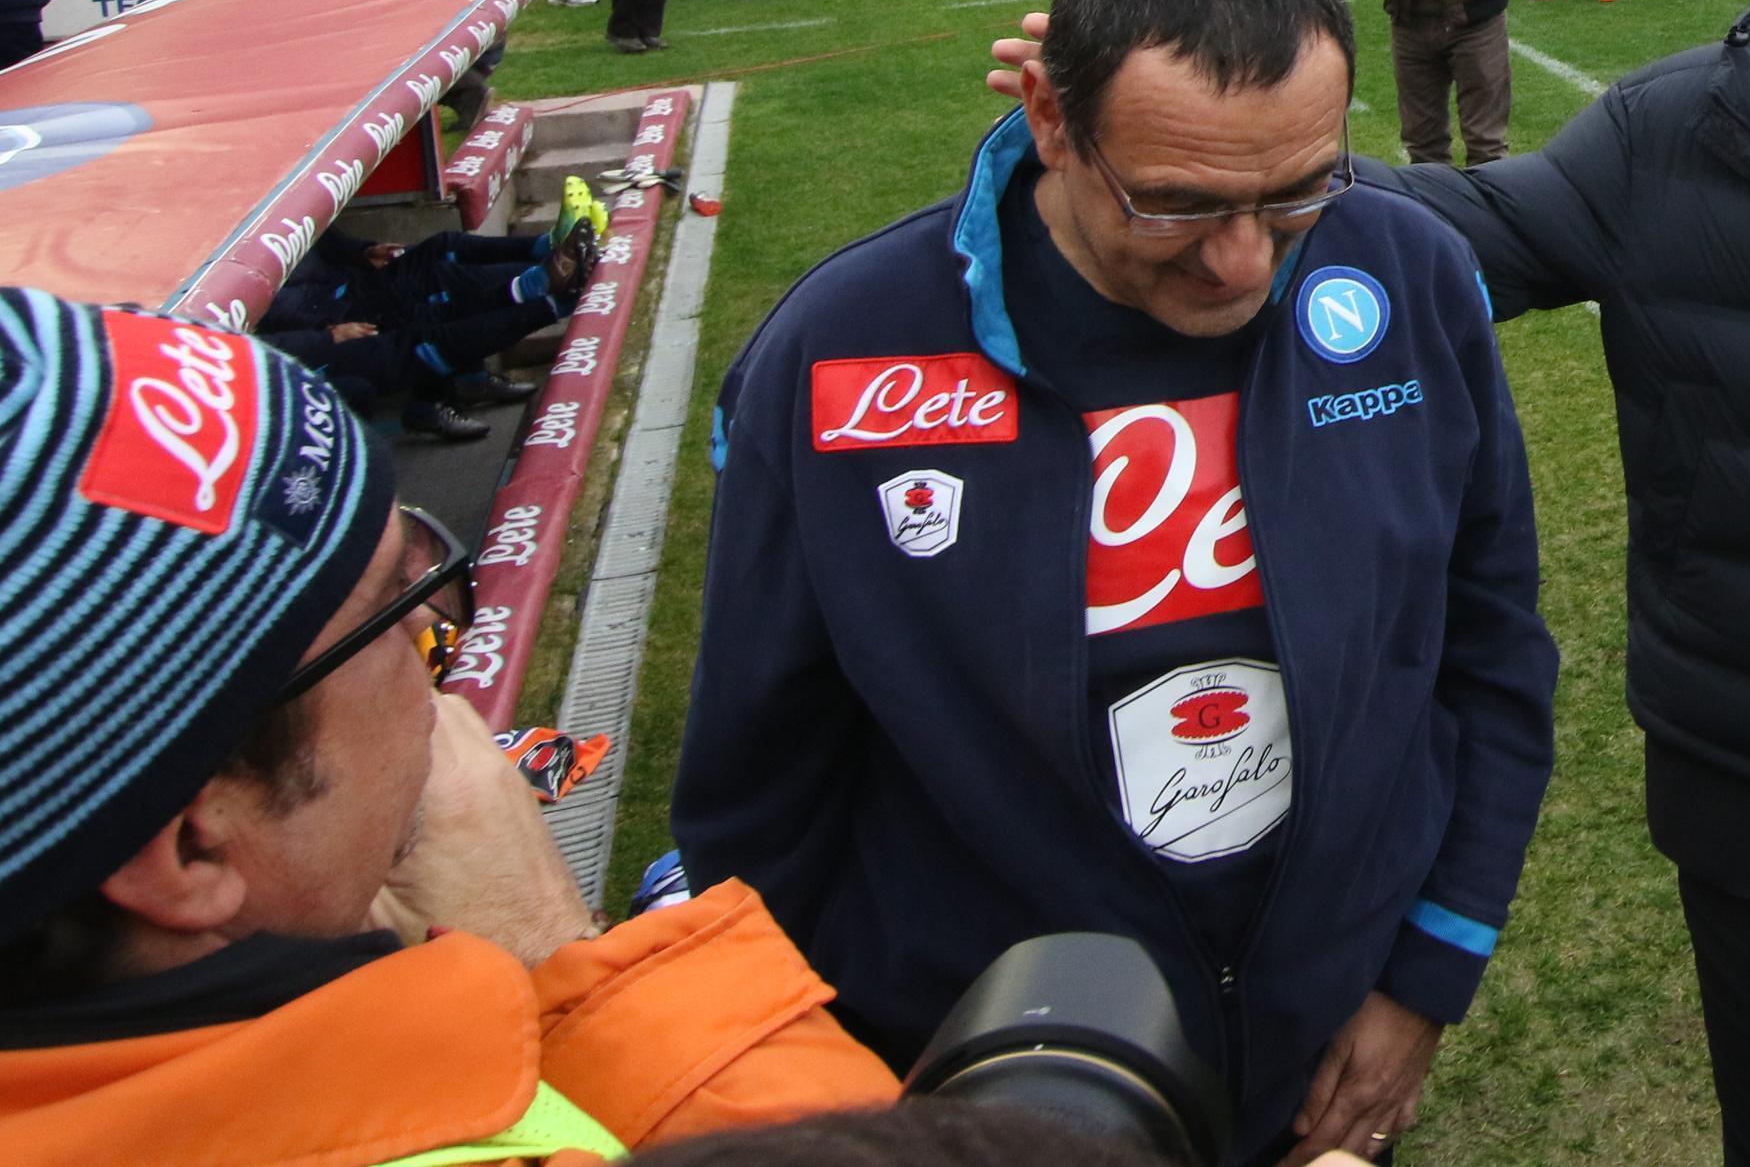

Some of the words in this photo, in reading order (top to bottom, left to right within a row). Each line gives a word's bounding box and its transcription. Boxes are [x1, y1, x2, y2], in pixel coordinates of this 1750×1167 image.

[573, 281, 618, 316] Lete
[551, 336, 600, 377] Lete
[130, 327, 240, 511] Lete
[300, 381, 334, 472] MSC
[525, 401, 580, 450] Lete
[821, 362, 1006, 442] Lete
[1308, 380, 1423, 427] Kappa
[478, 504, 543, 568] Lete
[1088, 404, 1258, 634] Le
[447, 606, 512, 689] Lete
[1140, 743, 1290, 840] Garofalo
